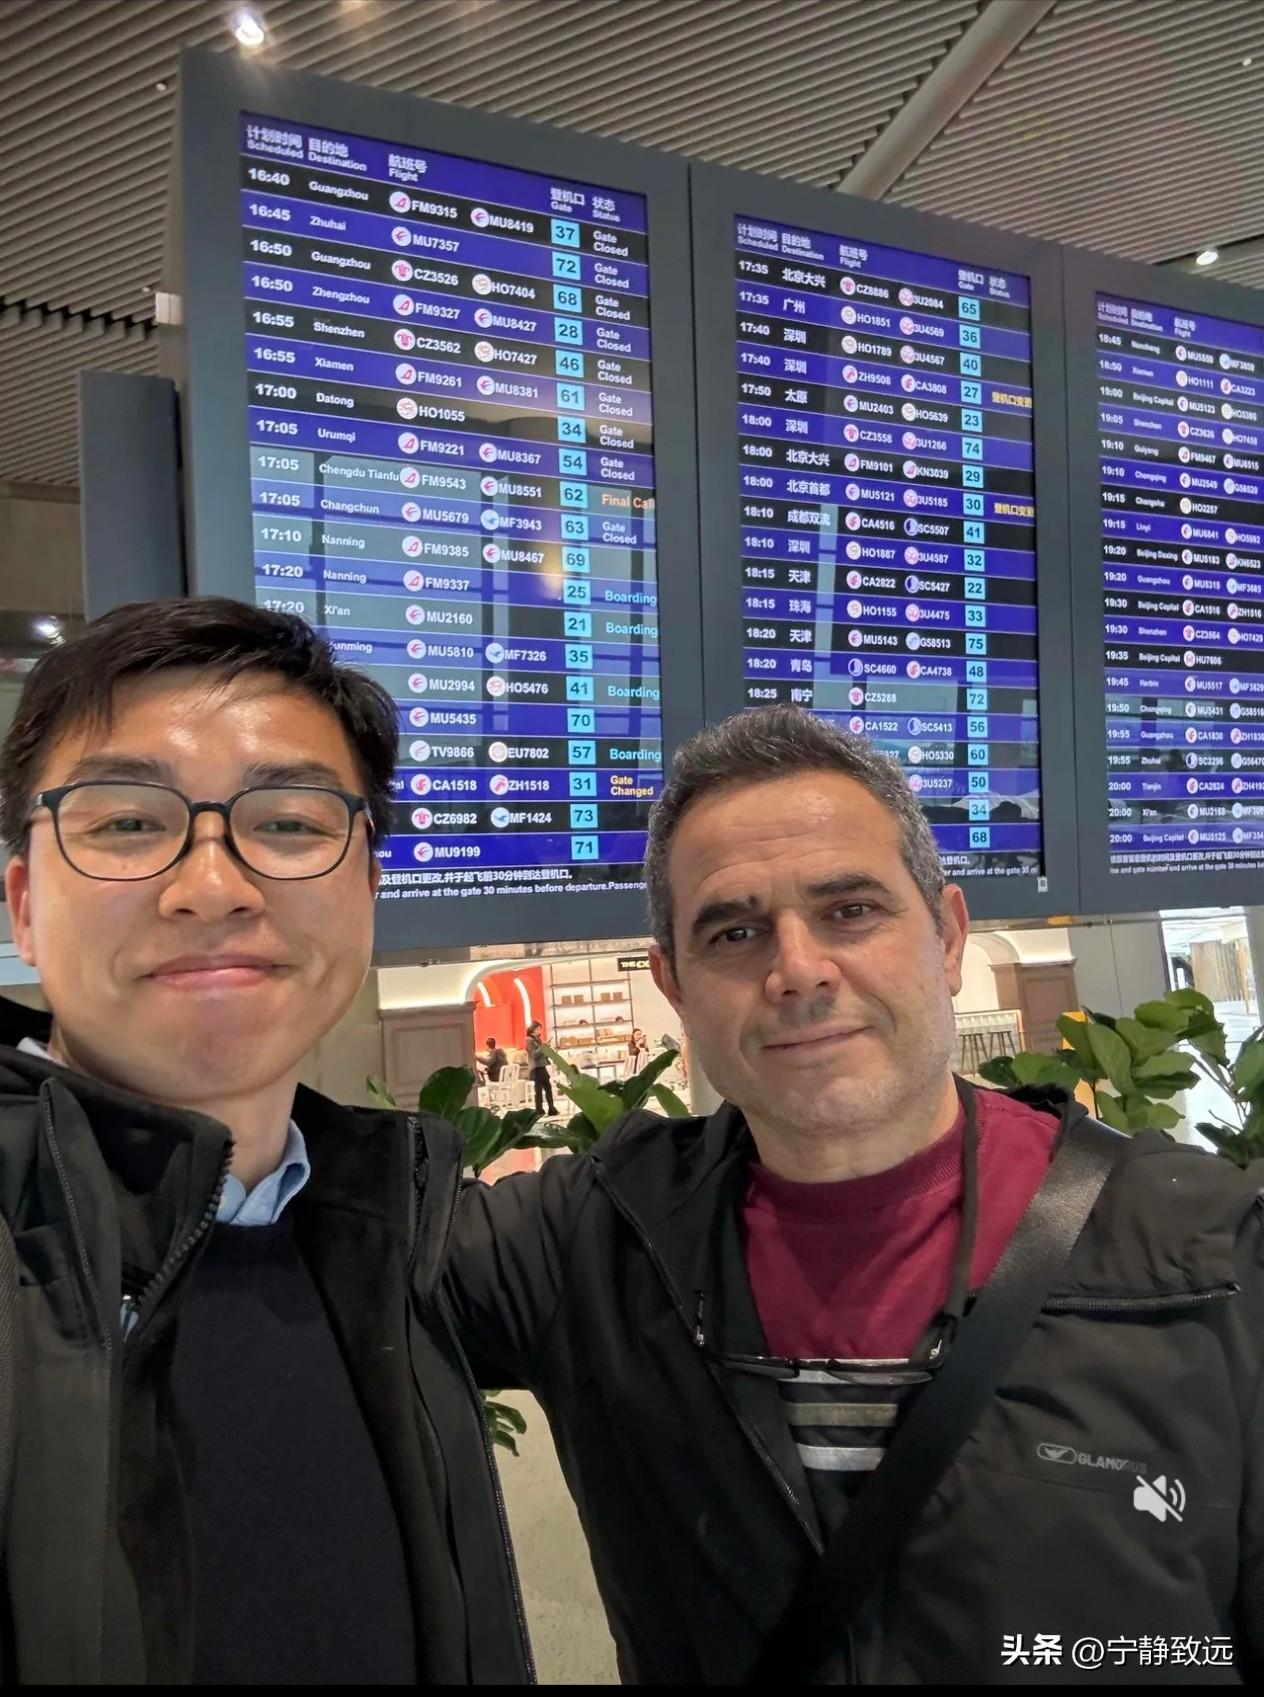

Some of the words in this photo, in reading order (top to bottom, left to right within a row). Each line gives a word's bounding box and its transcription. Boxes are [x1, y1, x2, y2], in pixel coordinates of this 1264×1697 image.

[247, 126, 302, 149] 计划时间
[309, 138, 348, 158] 目的地
[389, 154, 427, 175] 航班号
[551, 188, 585, 207] 登机口
[248, 140, 303, 159] Scheduled
[307, 151, 366, 173] Destination
[389, 168, 417, 181] Flight
[551, 201, 572, 212] Gate
[249, 168, 289, 185] 16:40
[309, 181, 368, 200] Guangzhou
[412, 200, 457, 218] FM9315
[488, 214, 533, 232] MU8419
[556, 226, 574, 240] 37
[250, 204, 290, 220] 16:45
[310, 216, 346, 230] Zhuhai
[413, 234, 459, 251] MU7357
[557, 258, 576, 273] 72
[594, 231, 617, 245] Gate
[594, 242, 628, 256] Closed
[251, 240, 292, 256] 16:50
[312, 252, 370, 269] Guangzhou
[414, 269, 458, 285] CZ3526
[490, 281, 535, 299] HO7404
[558, 291, 576, 305] 68
[739, 261, 768, 274] 17:35
[782, 268, 825, 287] 北京大兴
[962, 303, 976, 314] 65
[252, 276, 292, 291] 16:50
[313, 287, 369, 303] Zhengzhou
[416, 303, 460, 319] FM9327
[491, 314, 536, 331] MU8427
[559, 324, 578, 338] 28
[783, 299, 805, 313] 广州
[857, 313, 890, 327] HO1851
[963, 330, 977, 342] 36
[253, 312, 294, 327] 16:55
[314, 322, 364, 337] Shenzhen
[417, 338, 460, 353] CZ3562
[493, 347, 537, 364] HO7427
[560, 357, 579, 371] 46
[254, 348, 295, 363] 16:55
[315, 357, 353, 371] Xiamen
[418, 372, 461, 387] FM9261
[494, 381, 538, 398] MU8381
[561, 390, 578, 403] 61
[964, 386, 978, 398] 27
[256, 384, 296, 399] 17:00
[317, 393, 353, 408] Datong
[419, 406, 465, 421] HO1055
[562, 423, 581, 436] 34
[257, 420, 297, 434] 17:05
[318, 428, 355, 442] Urumqi
[421, 440, 464, 455] FM9221
[496, 448, 541, 464] MU8367
[564, 455, 582, 469] 54
[742, 415, 771, 426] 18:00
[860, 431, 892, 443] CZ3558
[965, 442, 979, 454] 74
[743, 445, 772, 457] 18:00
[786, 450, 829, 466] 北京大兴
[861, 460, 892, 472] FM9101
[916, 465, 948, 479] KN3039
[966, 471, 980, 482] 29
[258, 456, 298, 470] 17:05
[320, 464, 365, 477] Chengdu
[368, 469, 399, 480] Tianfu
[422, 475, 466, 489] FM9543
[497, 481, 541, 497] MU8551
[565, 488, 583, 501] 62
[602, 494, 630, 507] Final
[744, 476, 773, 487] 18:00
[787, 480, 830, 496] 北京首都
[861, 489, 894, 501] MU5121
[967, 499, 980, 510] 30
[1103, 492, 1125, 503] 19:15
[259, 492, 300, 506] 17:05
[321, 499, 379, 514] Changchun
[423, 508, 469, 523] MU5679
[499, 515, 542, 530] MF3943
[566, 521, 584, 534] 63
[744, 506, 773, 518] 18:10
[916, 522, 949, 535] SC5507
[967, 527, 979, 538] 41
[261, 528, 301, 541] 17:10
[322, 535, 365, 549] Nanning
[425, 543, 469, 557] FM9385
[500, 549, 544, 563] MU8467
[567, 553, 584, 566] 69
[1104, 545, 1126, 555] 19:20
[262, 564, 303, 577] 17:20
[324, 570, 366, 584] Nanning
[426, 577, 469, 590] FM9337
[568, 586, 586, 598] 25
[605, 591, 657, 607] Boarding
[745, 567, 775, 578] 18:15
[789, 570, 810, 583] 天津
[863, 577, 895, 588] CA2822
[918, 580, 950, 591] SC5427
[968, 583, 982, 593] 22
[325, 605, 350, 615] Xi'an
[427, 611, 472, 624] MU2160
[569, 618, 585, 630] 21
[606, 622, 657, 638] Boarding
[428, 646, 473, 657] MU5810
[503, 648, 546, 661] MF7326
[570, 650, 588, 662] 35
[864, 635, 897, 645] MU5143
[969, 638, 983, 649] 75
[919, 665, 951, 676] CA4738
[969, 666, 983, 677] 48
[1107, 677, 1128, 686] 19:45
[430, 679, 475, 691] MU2994
[505, 682, 548, 694] HO5476
[571, 682, 587, 694] 41
[608, 685, 659, 701] Boarding
[431, 713, 476, 724] MU5435
[572, 714, 590, 726] 70
[865, 722, 897, 731] CA1522
[971, 722, 984, 732] 56
[431, 746, 474, 757] TV9866
[506, 746, 549, 759] EU7802
[573, 746, 591, 758] 57
[610, 749, 661, 763] Boarding
[921, 749, 954, 760] HO5330
[971, 749, 985, 760] 60
[431, 780, 477, 790] CA1518
[507, 778, 549, 792] ZH1518
[574, 778, 590, 790] 31
[611, 776, 633, 784] Gate
[611, 786, 653, 797] Changed
[1109, 782, 1131, 790] 20:00
[434, 813, 477, 824] CZ6982
[508, 811, 552, 825] MF1424
[575, 810, 593, 821] 73
[435, 847, 480, 857] MU9199
[576, 842, 592, 853] 71
[973, 832, 987, 842] 68
